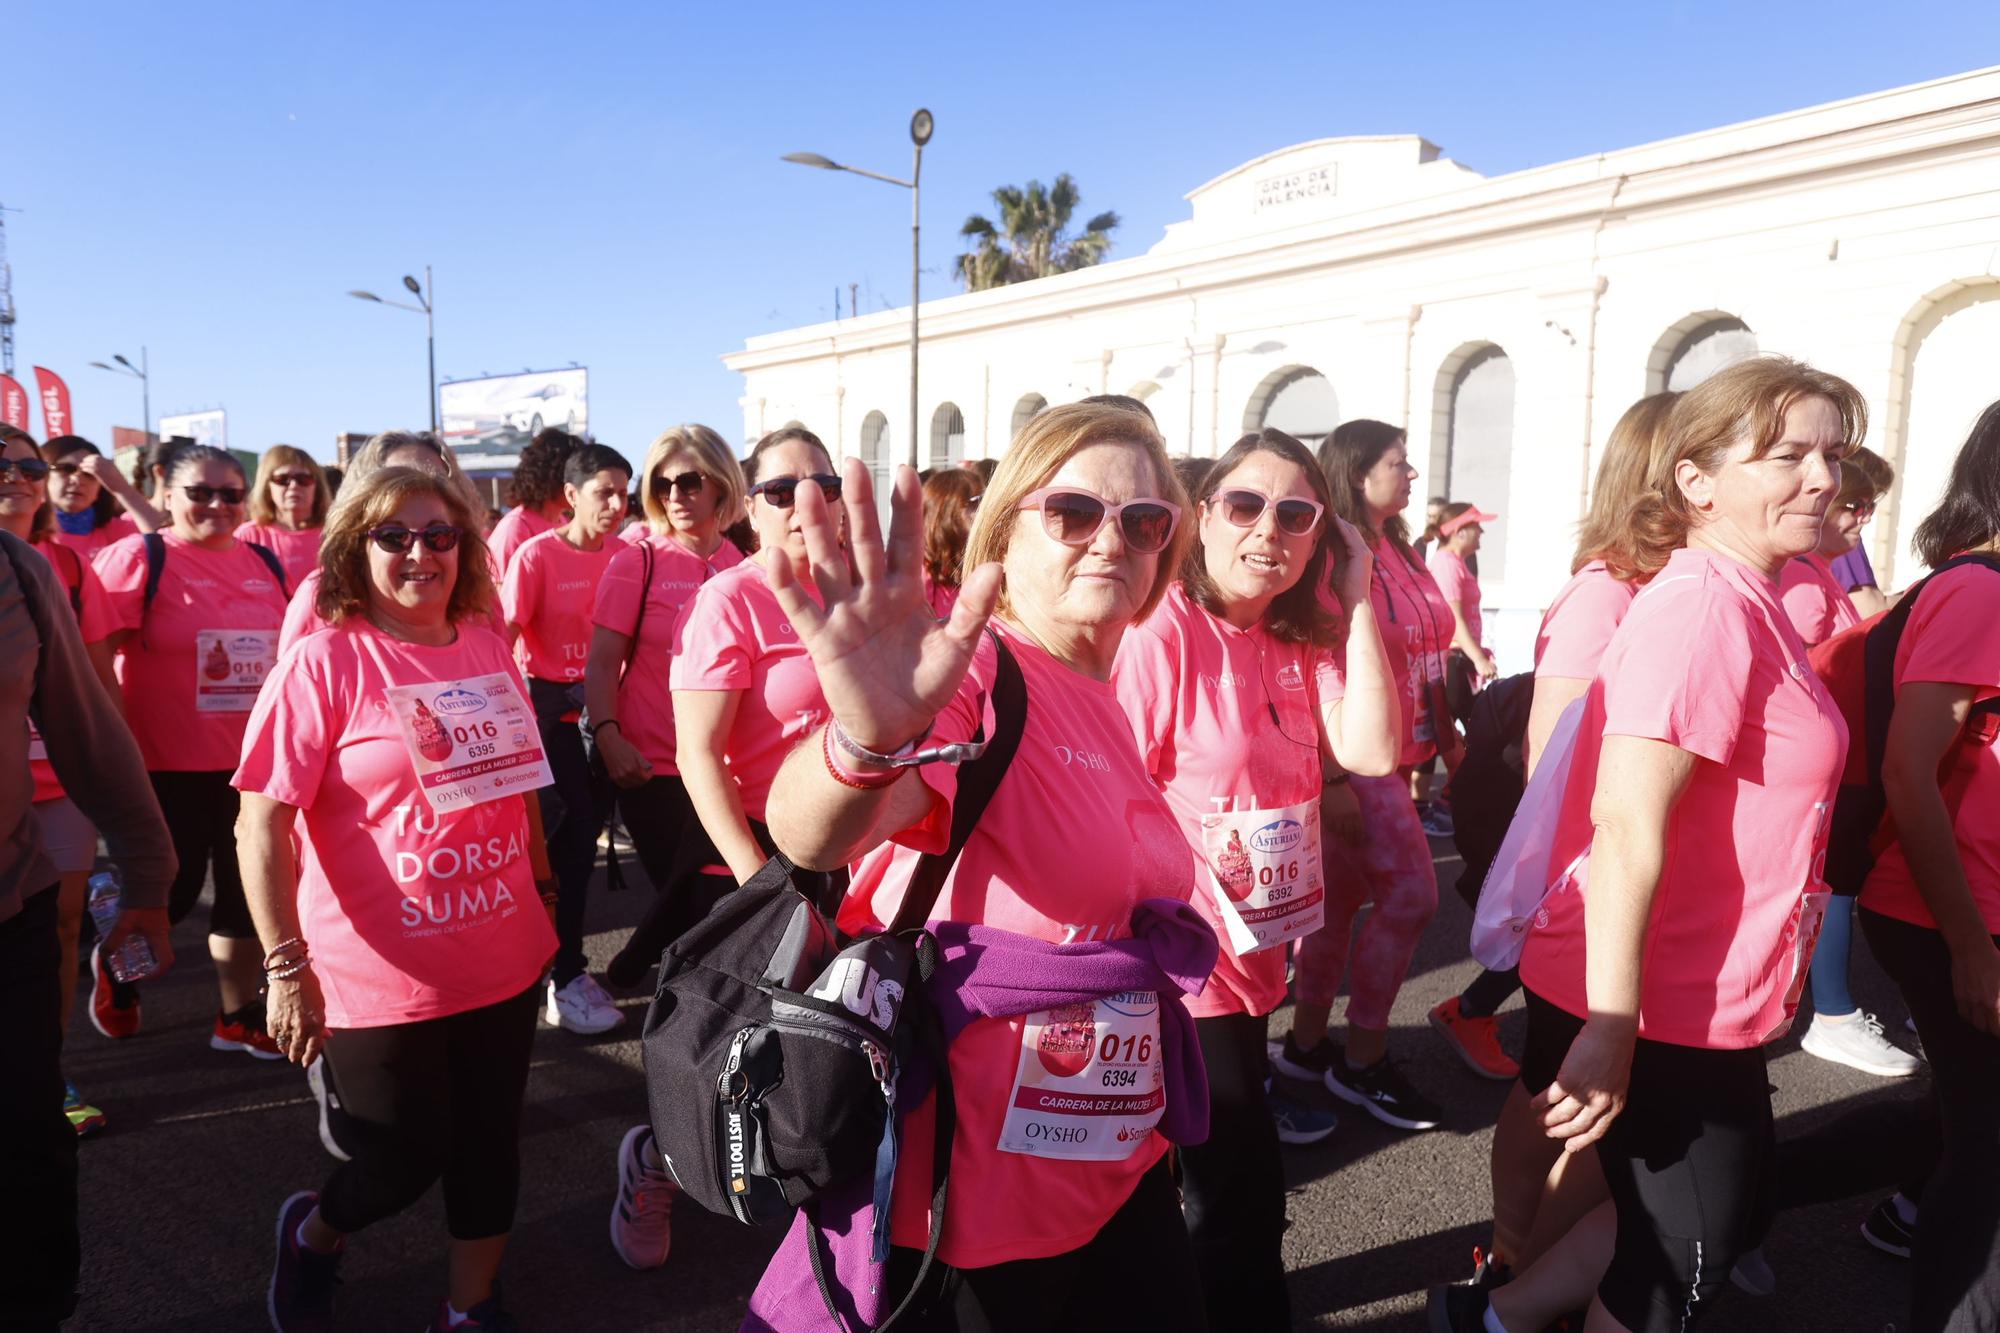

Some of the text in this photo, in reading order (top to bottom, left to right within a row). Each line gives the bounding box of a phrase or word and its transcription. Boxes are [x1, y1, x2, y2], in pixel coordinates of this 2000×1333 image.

[1309, 169, 1329, 183] DE
[1258, 182, 1331, 207] VALENCIA
[562, 643, 588, 660] TU
[233, 662, 263, 674] 016
[453, 720, 498, 744] 016
[468, 743, 496, 759] 6395
[435, 766, 472, 783] CARRERA
[472, 763, 481, 774] DE
[482, 760, 493, 771] LA
[493, 756, 517, 769] MUJER
[503, 769, 541, 786] Santander
[436, 784, 477, 804] OYSHO
[393, 804, 440, 837] TU
[1259, 860, 1299, 886] 016
[400, 876, 514, 928] SUMA
[1268, 886, 1294, 902] 6392
[1267, 908, 1280, 918] DE
[1279, 904, 1289, 915] LA
[1100, 1033, 1152, 1063] 016
[1102, 1069, 1138, 1087] 6394
[1039, 1095, 1093, 1111] CARRERA
[1095, 1101, 1111, 1111] DE
[1111, 1101, 1125, 1111] LA
[728, 1112, 743, 1142] JUST
[1025, 1122, 1088, 1143] OYSHO
[730, 1142, 744, 1163] DO
